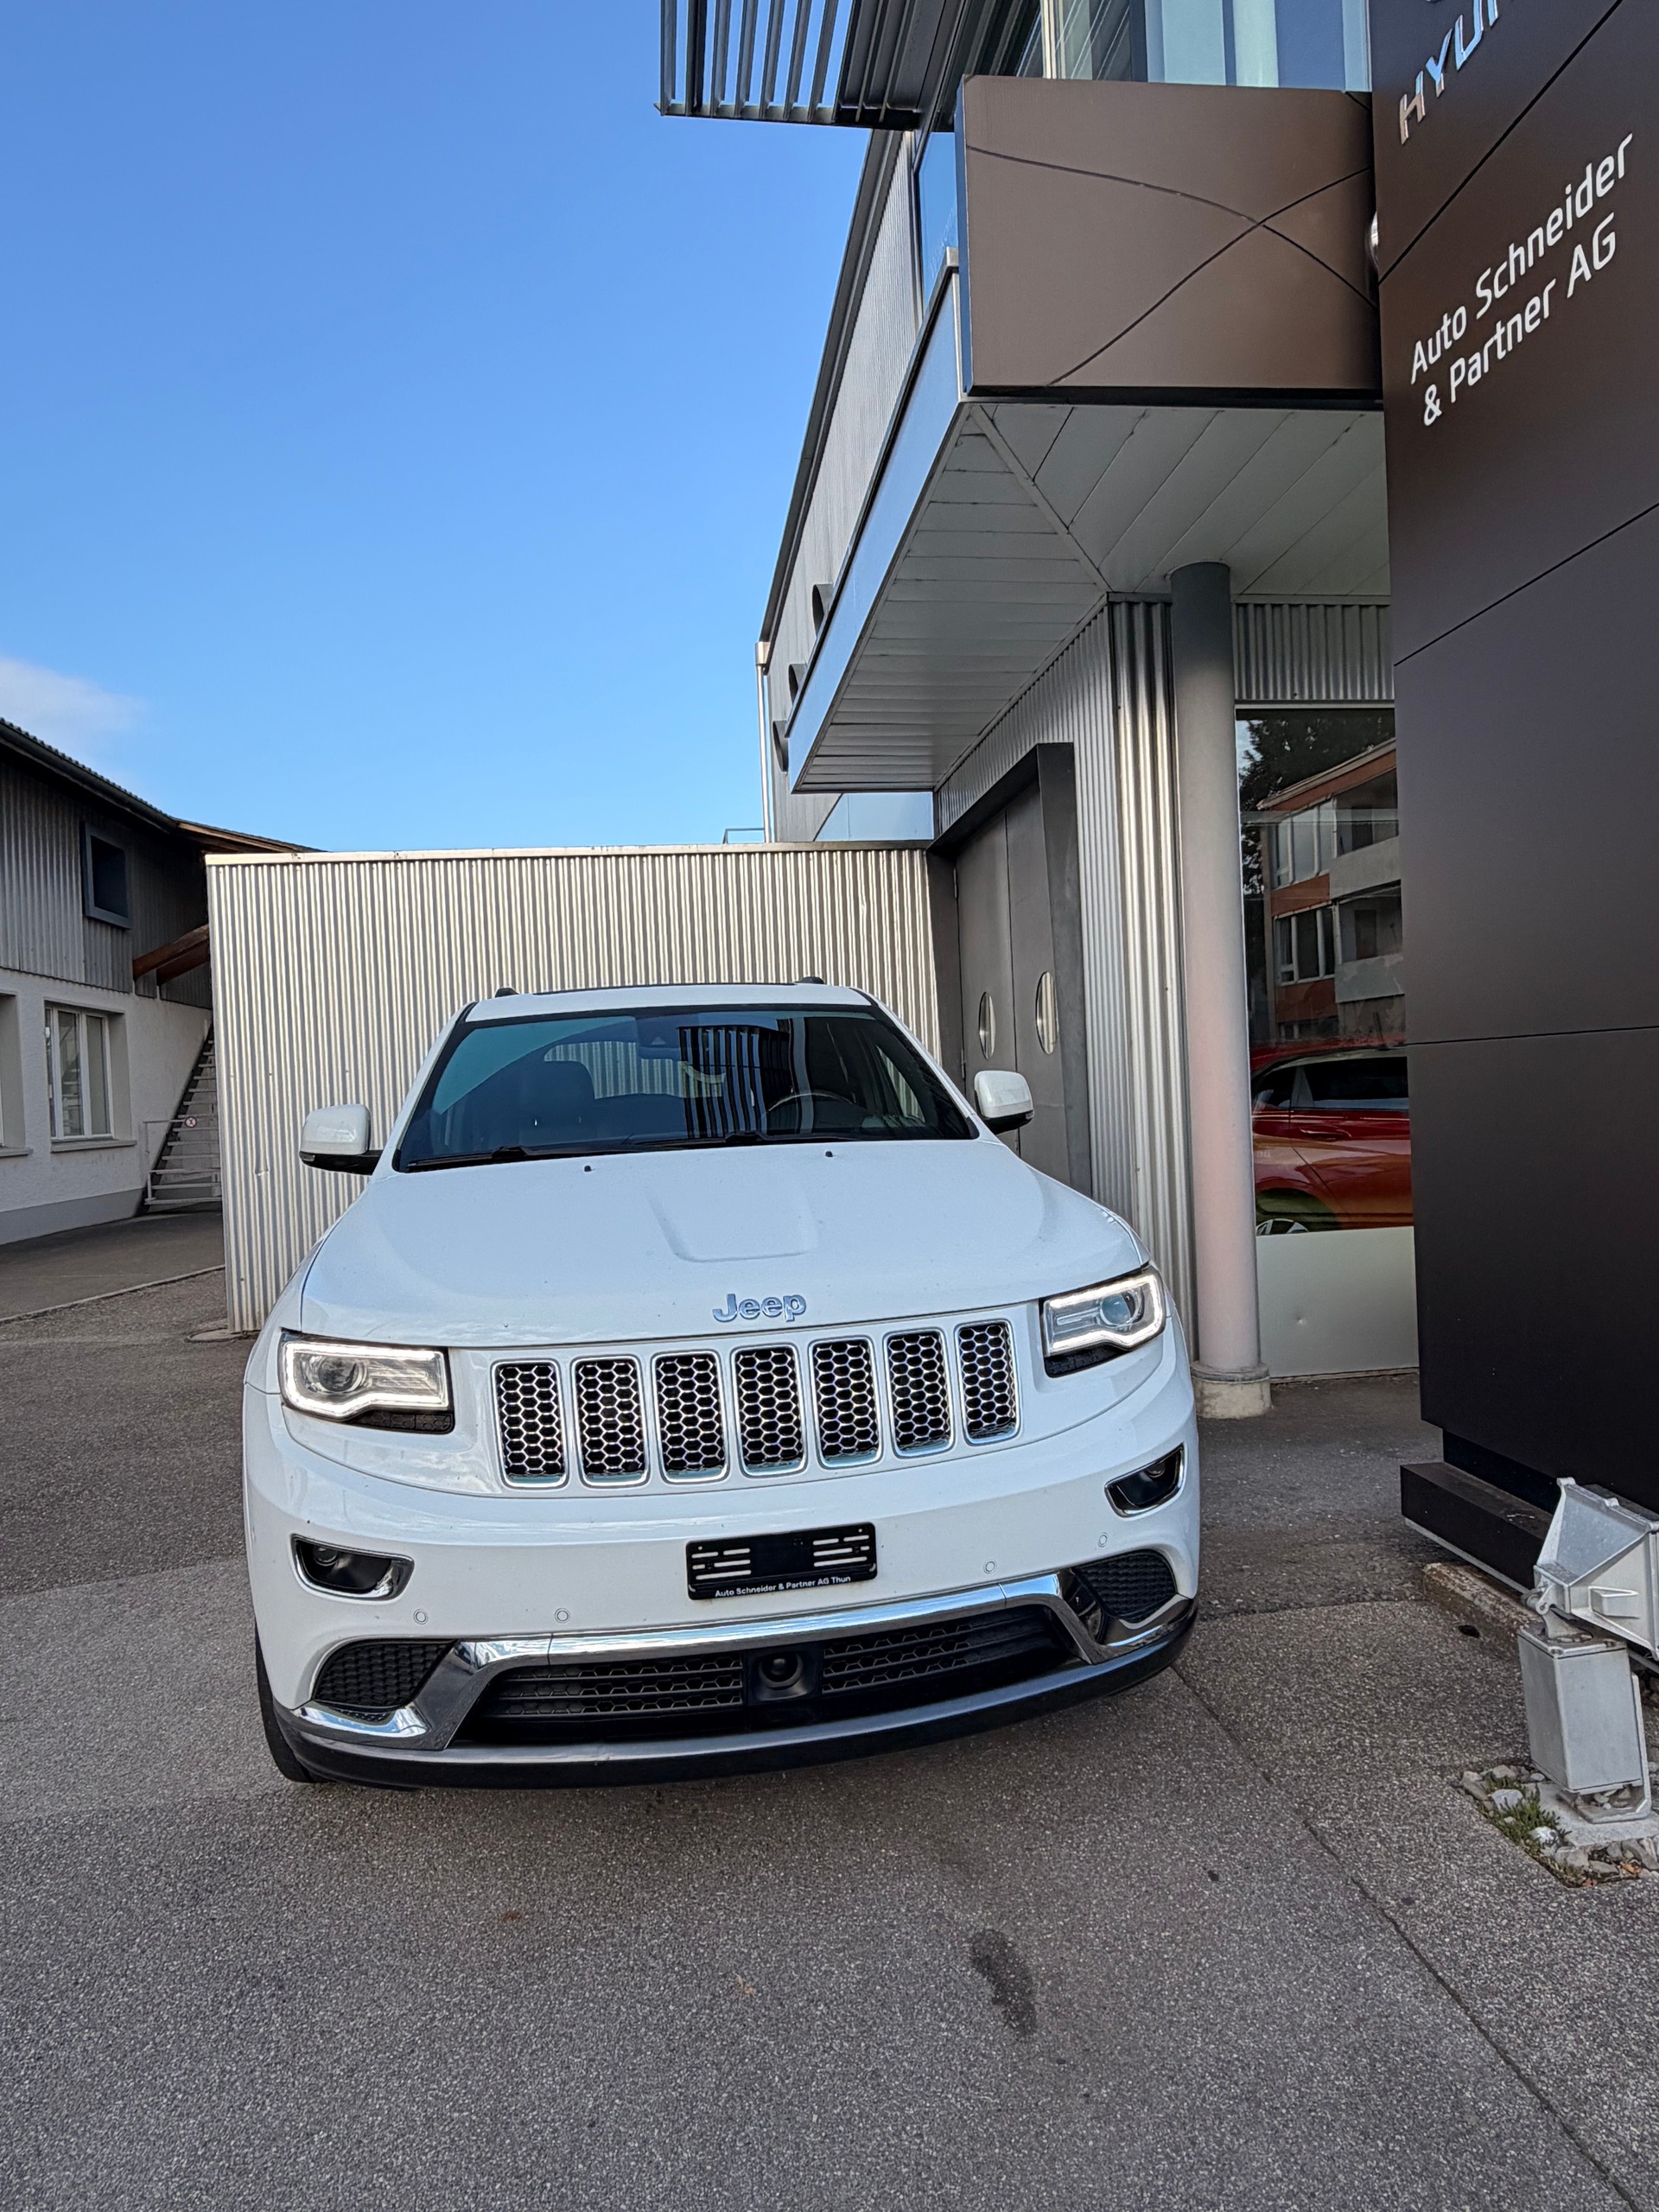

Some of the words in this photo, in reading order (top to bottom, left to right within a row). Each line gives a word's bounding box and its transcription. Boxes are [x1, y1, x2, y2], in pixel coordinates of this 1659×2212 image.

[1399, 0, 1499, 145] HYU
[1410, 305, 1467, 385] Auto
[1476, 133, 1633, 320] Schneider
[1423, 384, 1443, 426] &
[1450, 278, 1556, 404] Partner
[1567, 212, 1617, 298] AG
[712, 1293, 807, 1323] Jeep
[736, 1584, 777, 1595] Schneider
[785, 1580, 816, 1589] Partner
[817, 1577, 830, 1586] AG
[830, 1575, 851, 1584] Thun
